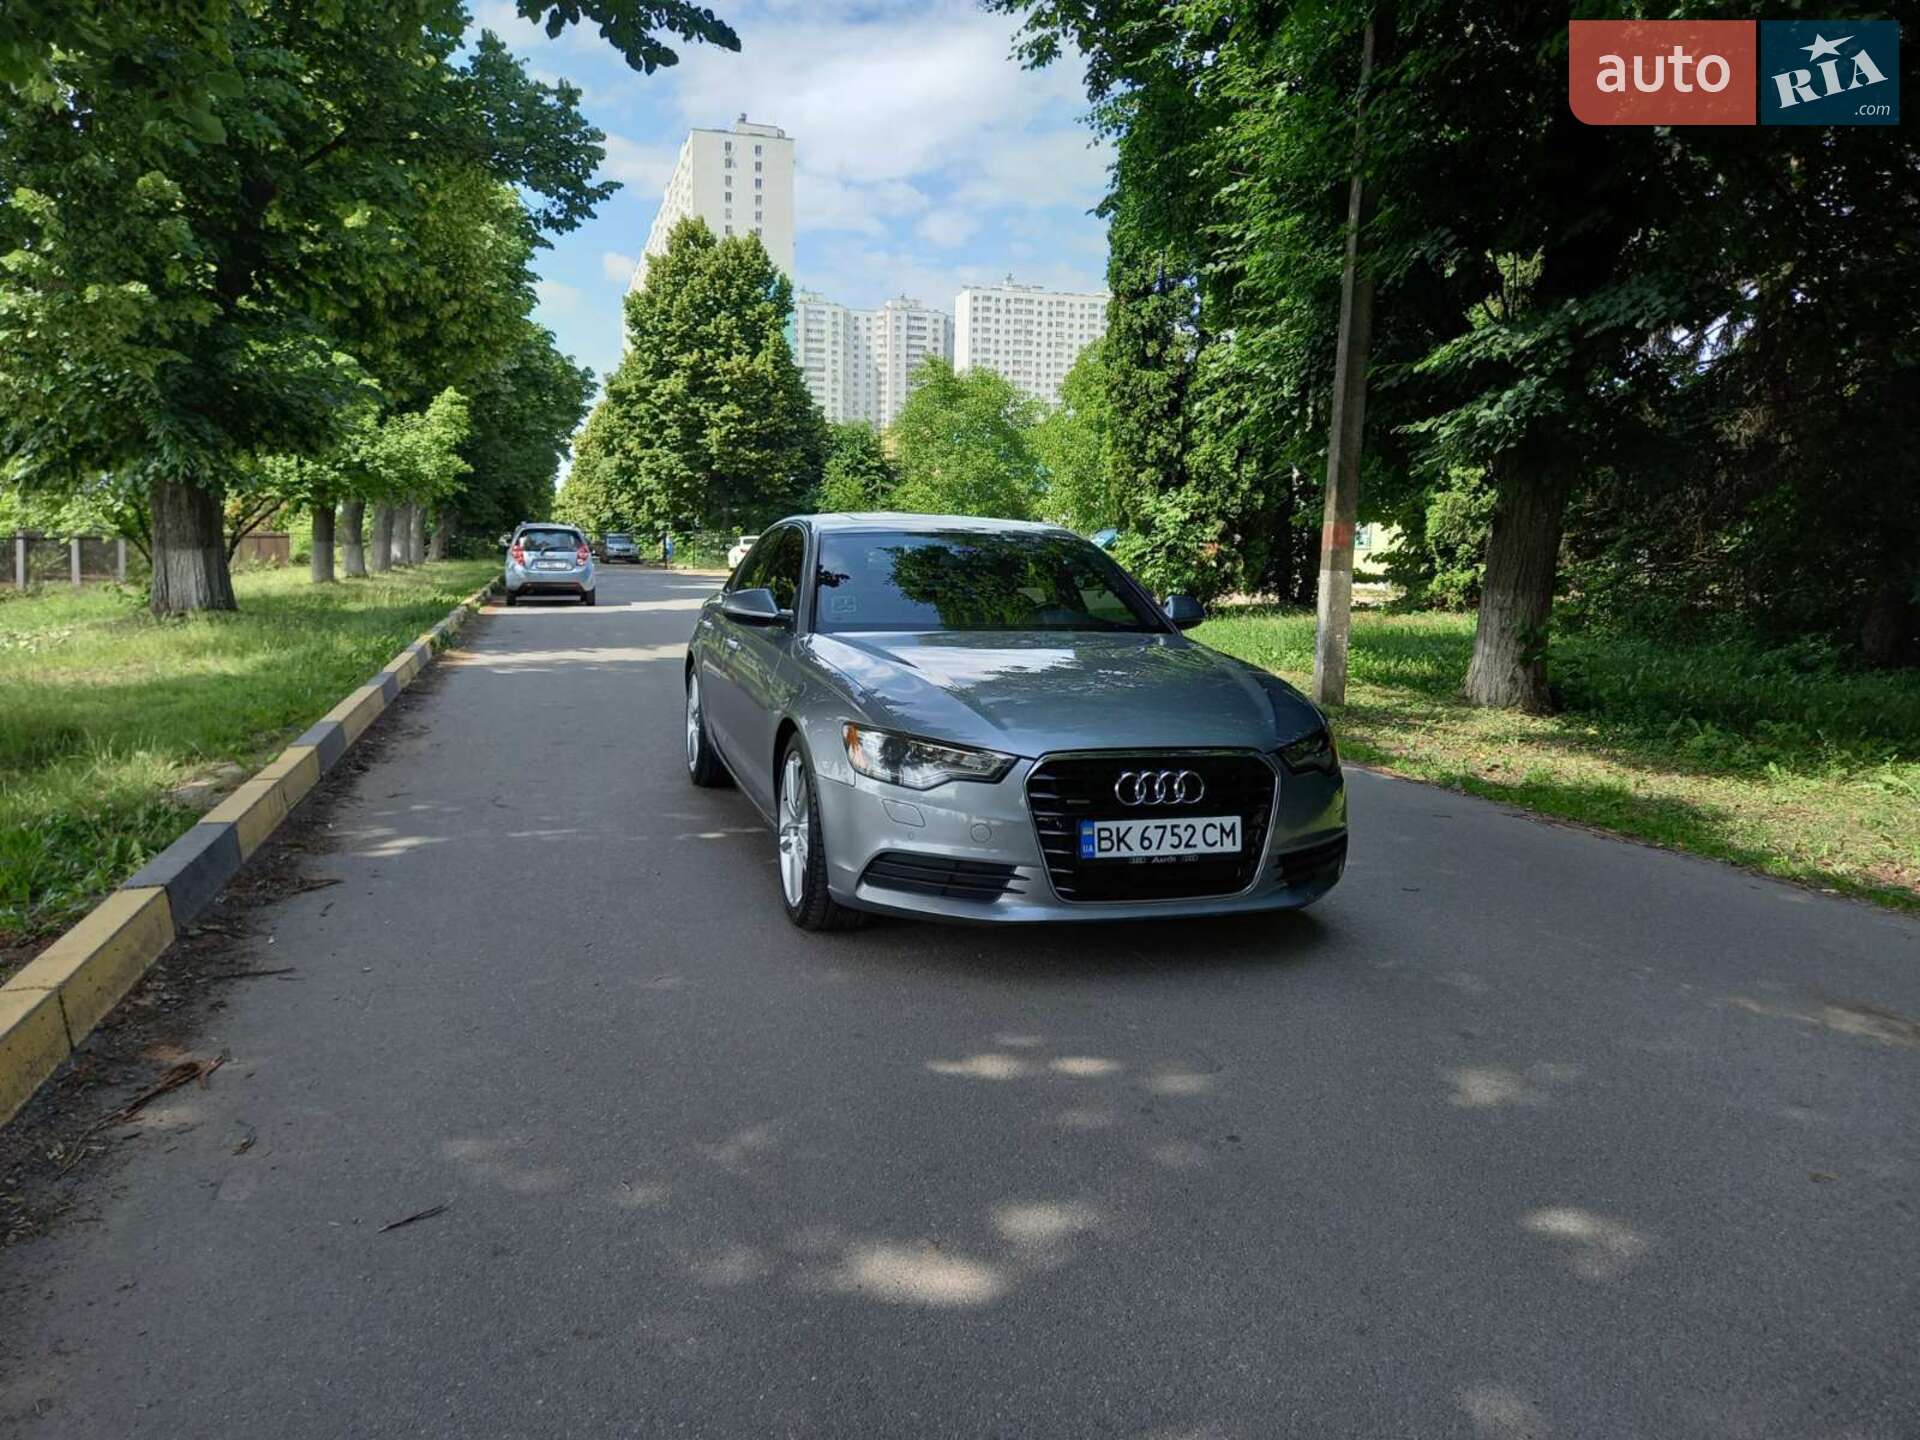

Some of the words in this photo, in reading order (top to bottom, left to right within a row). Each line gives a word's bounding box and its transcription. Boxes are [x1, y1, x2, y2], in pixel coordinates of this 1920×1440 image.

[1097, 826, 1133, 852] BK
[1139, 824, 1197, 850] 6752
[1202, 822, 1236, 847] CM
